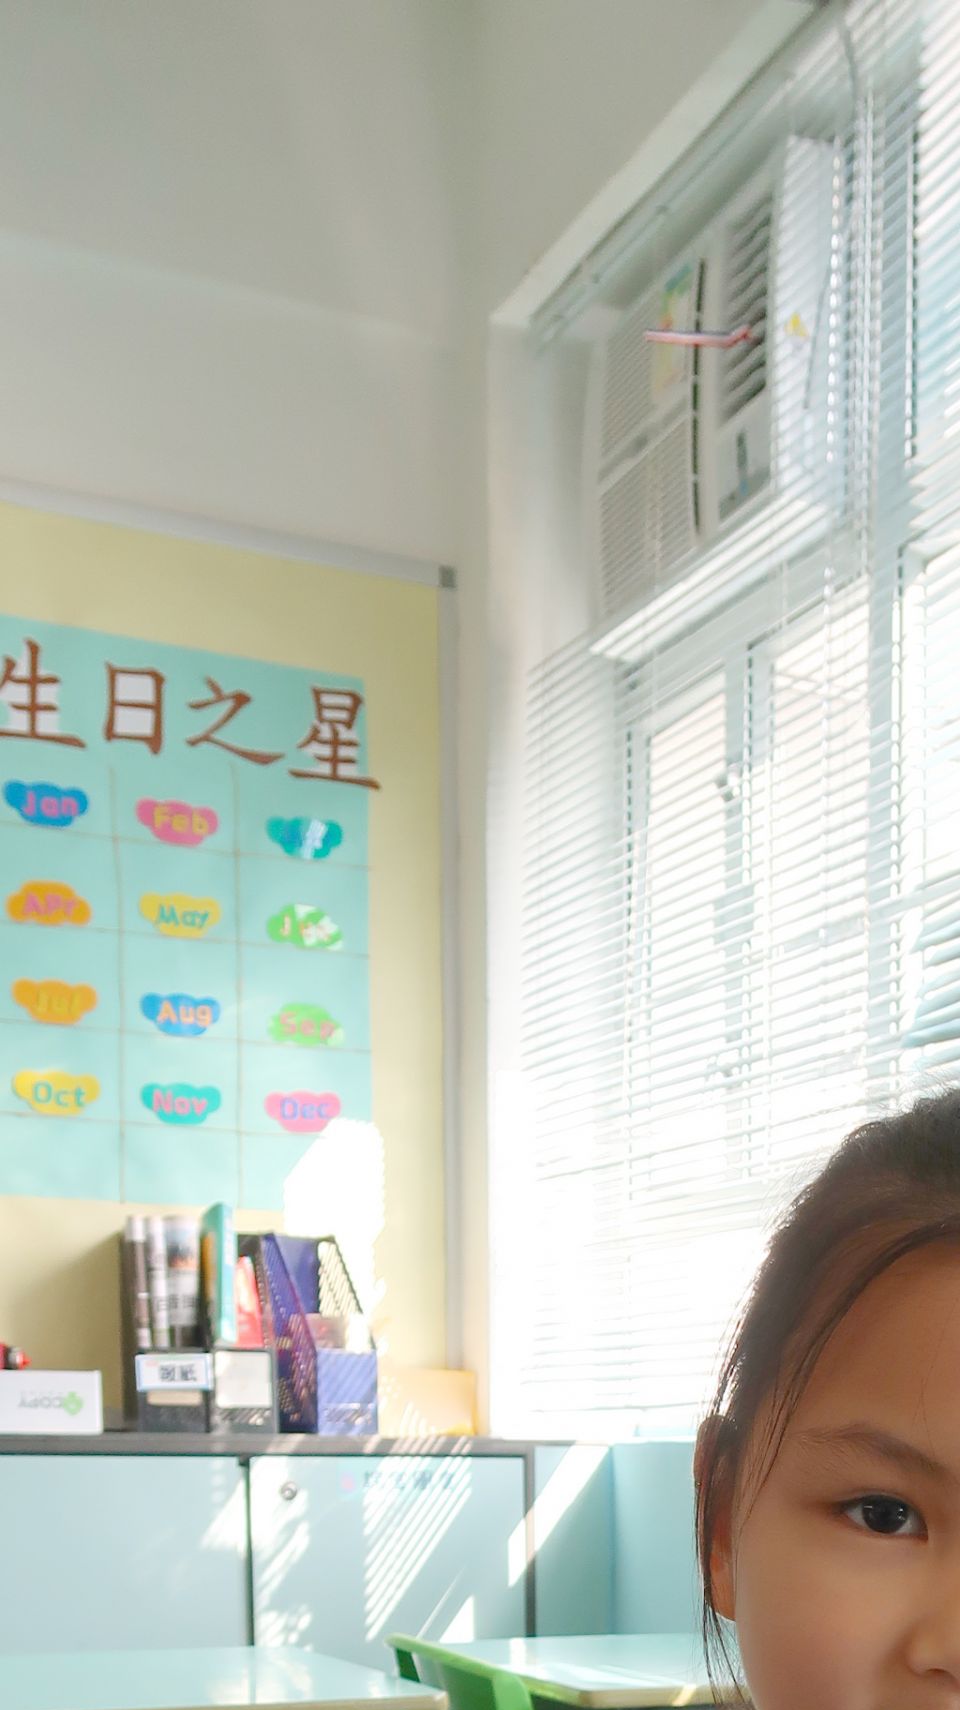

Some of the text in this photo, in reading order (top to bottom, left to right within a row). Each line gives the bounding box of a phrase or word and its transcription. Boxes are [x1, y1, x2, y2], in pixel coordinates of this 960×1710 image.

[0, 637, 382, 790] 生日之星
[24, 791, 79, 818] Jan
[154, 803, 209, 836] Feb
[156, 905, 210, 929] May
[36, 989, 82, 1016] Jul
[157, 1001, 213, 1027] Aug
[279, 1011, 336, 1041] Sep
[32, 1082, 86, 1108] Oct
[153, 1088, 208, 1115] Nov
[280, 1097, 331, 1121] Dec
